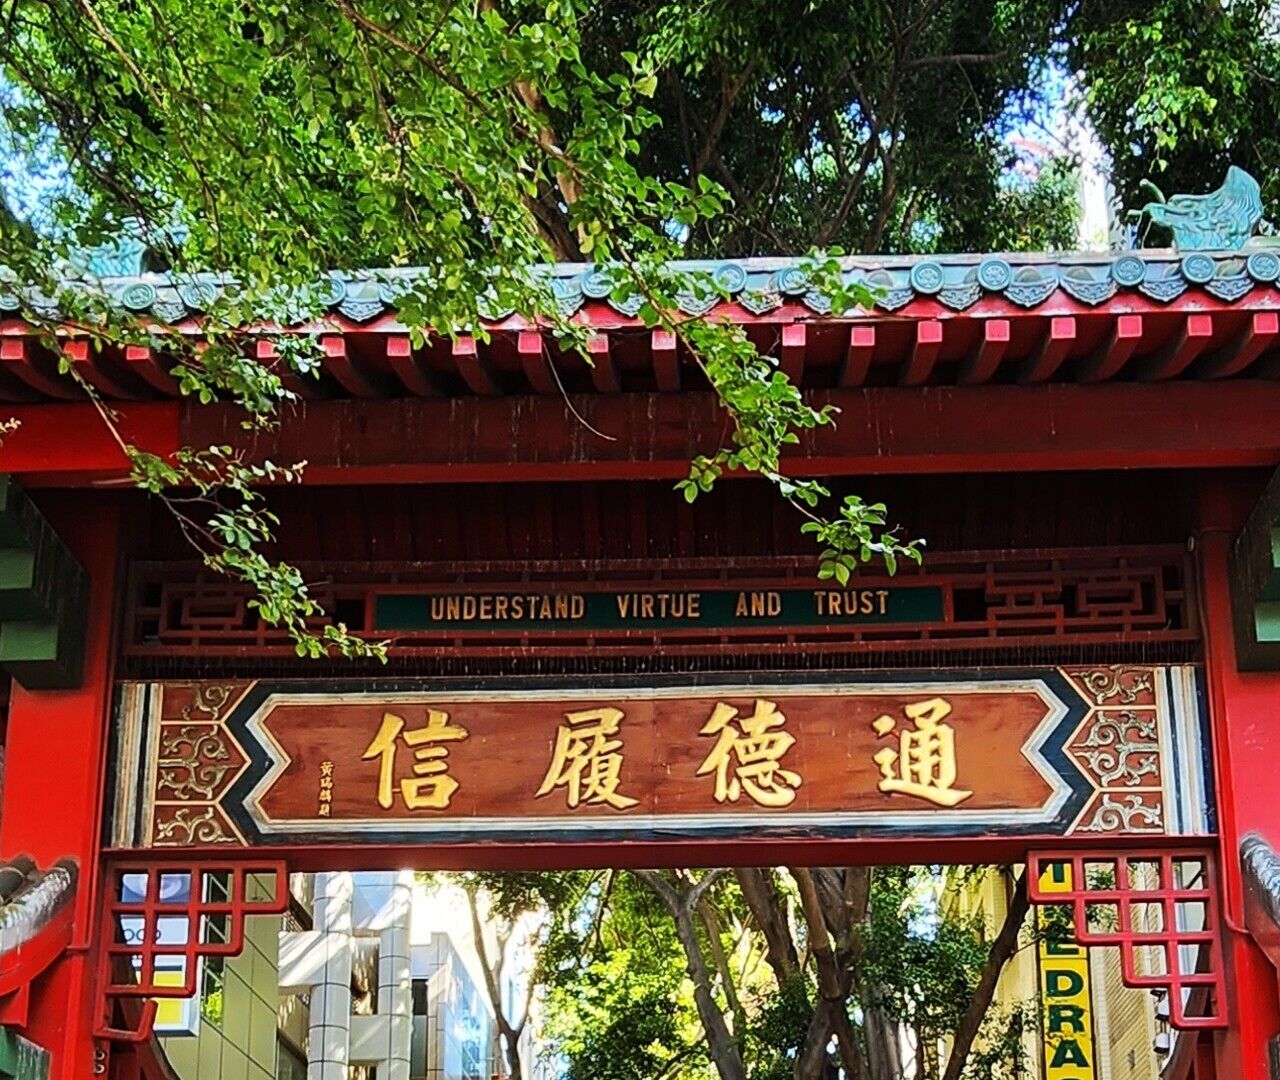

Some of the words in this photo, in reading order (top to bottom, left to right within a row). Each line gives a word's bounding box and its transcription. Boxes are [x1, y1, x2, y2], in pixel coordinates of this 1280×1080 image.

[431, 594, 585, 620] UNDERSTAND
[617, 592, 701, 618] VIRTUE
[735, 591, 782, 616] AND
[814, 589, 890, 615] TRUST
